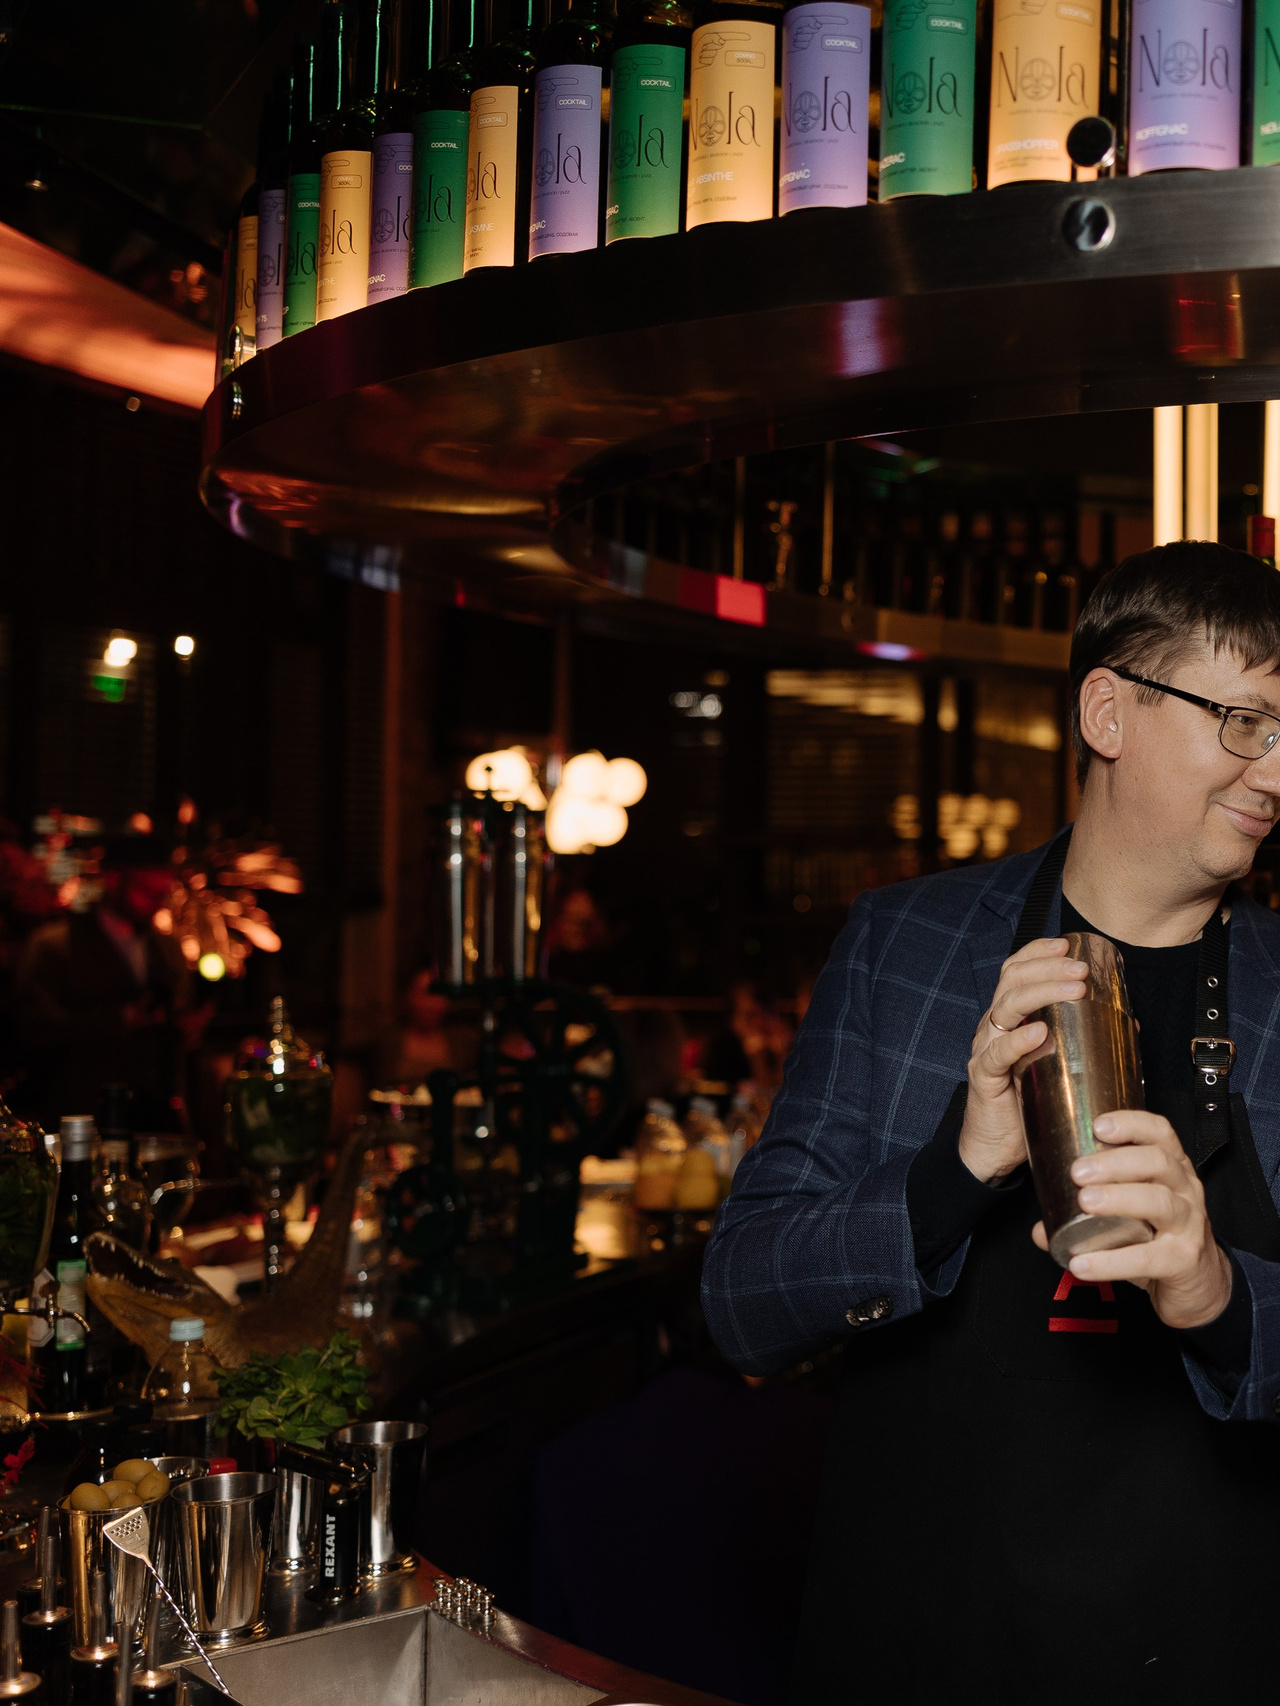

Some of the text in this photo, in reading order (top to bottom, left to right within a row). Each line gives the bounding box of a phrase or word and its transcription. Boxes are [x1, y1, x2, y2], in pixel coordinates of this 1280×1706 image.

[825, 38, 858, 49] COCKTAIL
[1138, 28, 1234, 94] Nola
[640, 79, 673, 88] COCKTAIL
[997, 45, 1090, 109] Nola
[479, 117, 504, 125] COCKTAIL
[696, 171, 735, 185] ABSINTHE
[325, 1513, 336, 1578] REXANT
